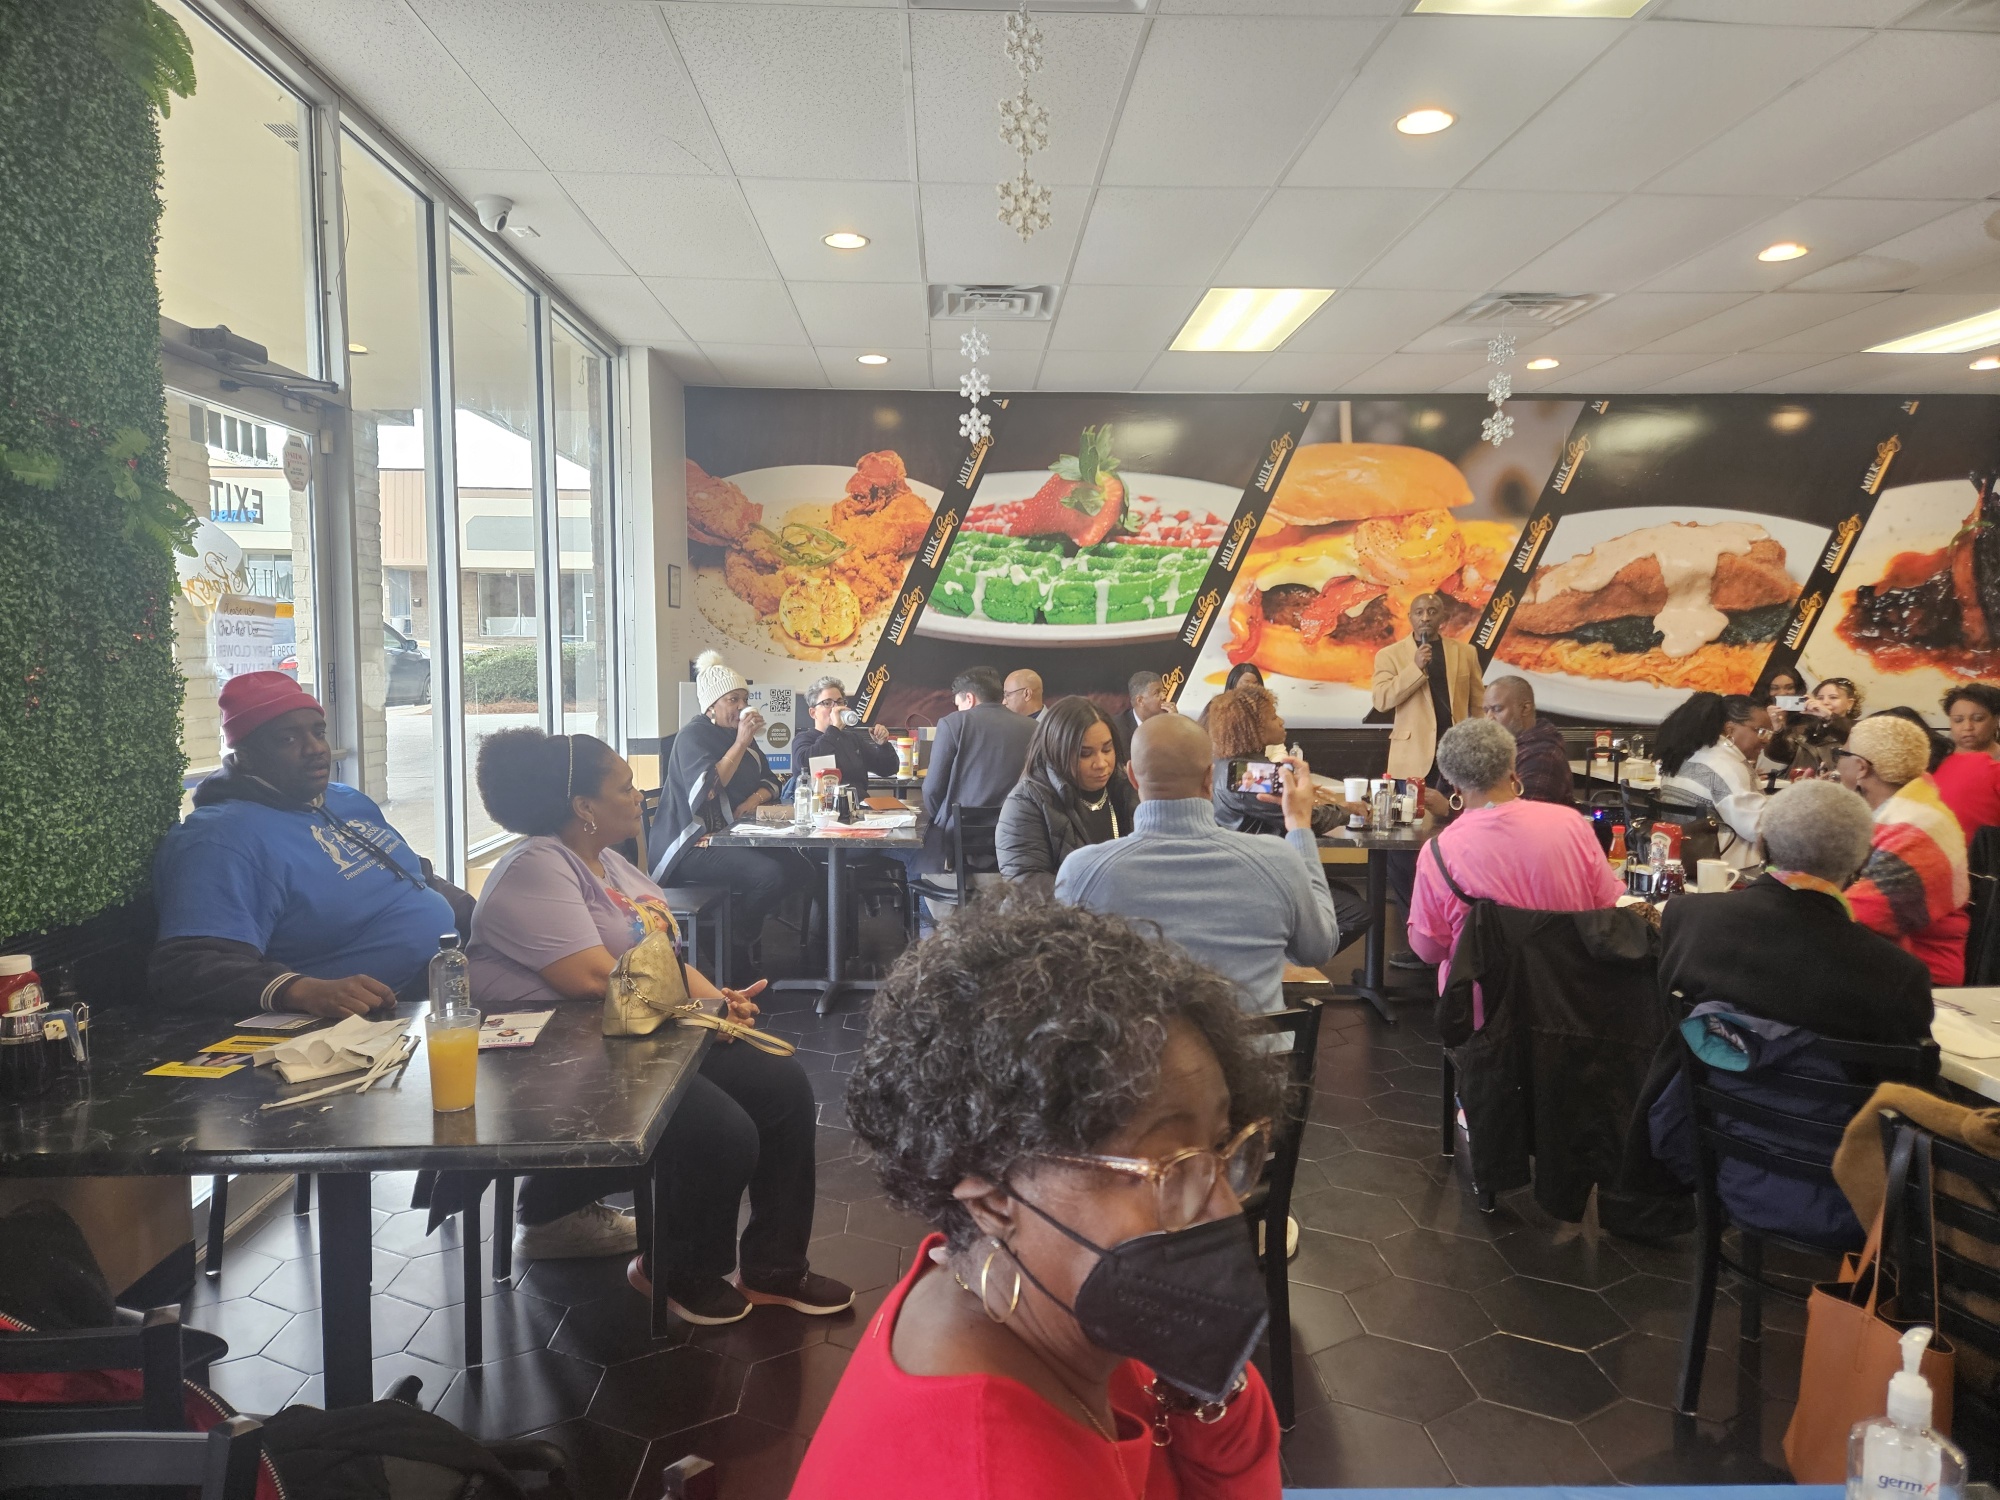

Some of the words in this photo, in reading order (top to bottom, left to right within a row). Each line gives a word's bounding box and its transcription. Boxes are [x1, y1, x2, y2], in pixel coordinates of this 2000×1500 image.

[957, 457, 976, 487] MILK
[1254, 460, 1275, 490] MILK
[1552, 462, 1572, 492] MILK
[1860, 462, 1880, 492] MILK
[922, 536, 941, 566] MILK
[1218, 539, 1238, 569] MILK
[1513, 541, 1533, 571] MILK
[1822, 541, 1842, 571] MILK
[888, 614, 906, 644] MILK
[1182, 616, 1202, 646] MILK
[1476, 618, 1497, 647] MILK
[1783, 618, 1804, 648] MILK
[854, 692, 871, 721] MILK
